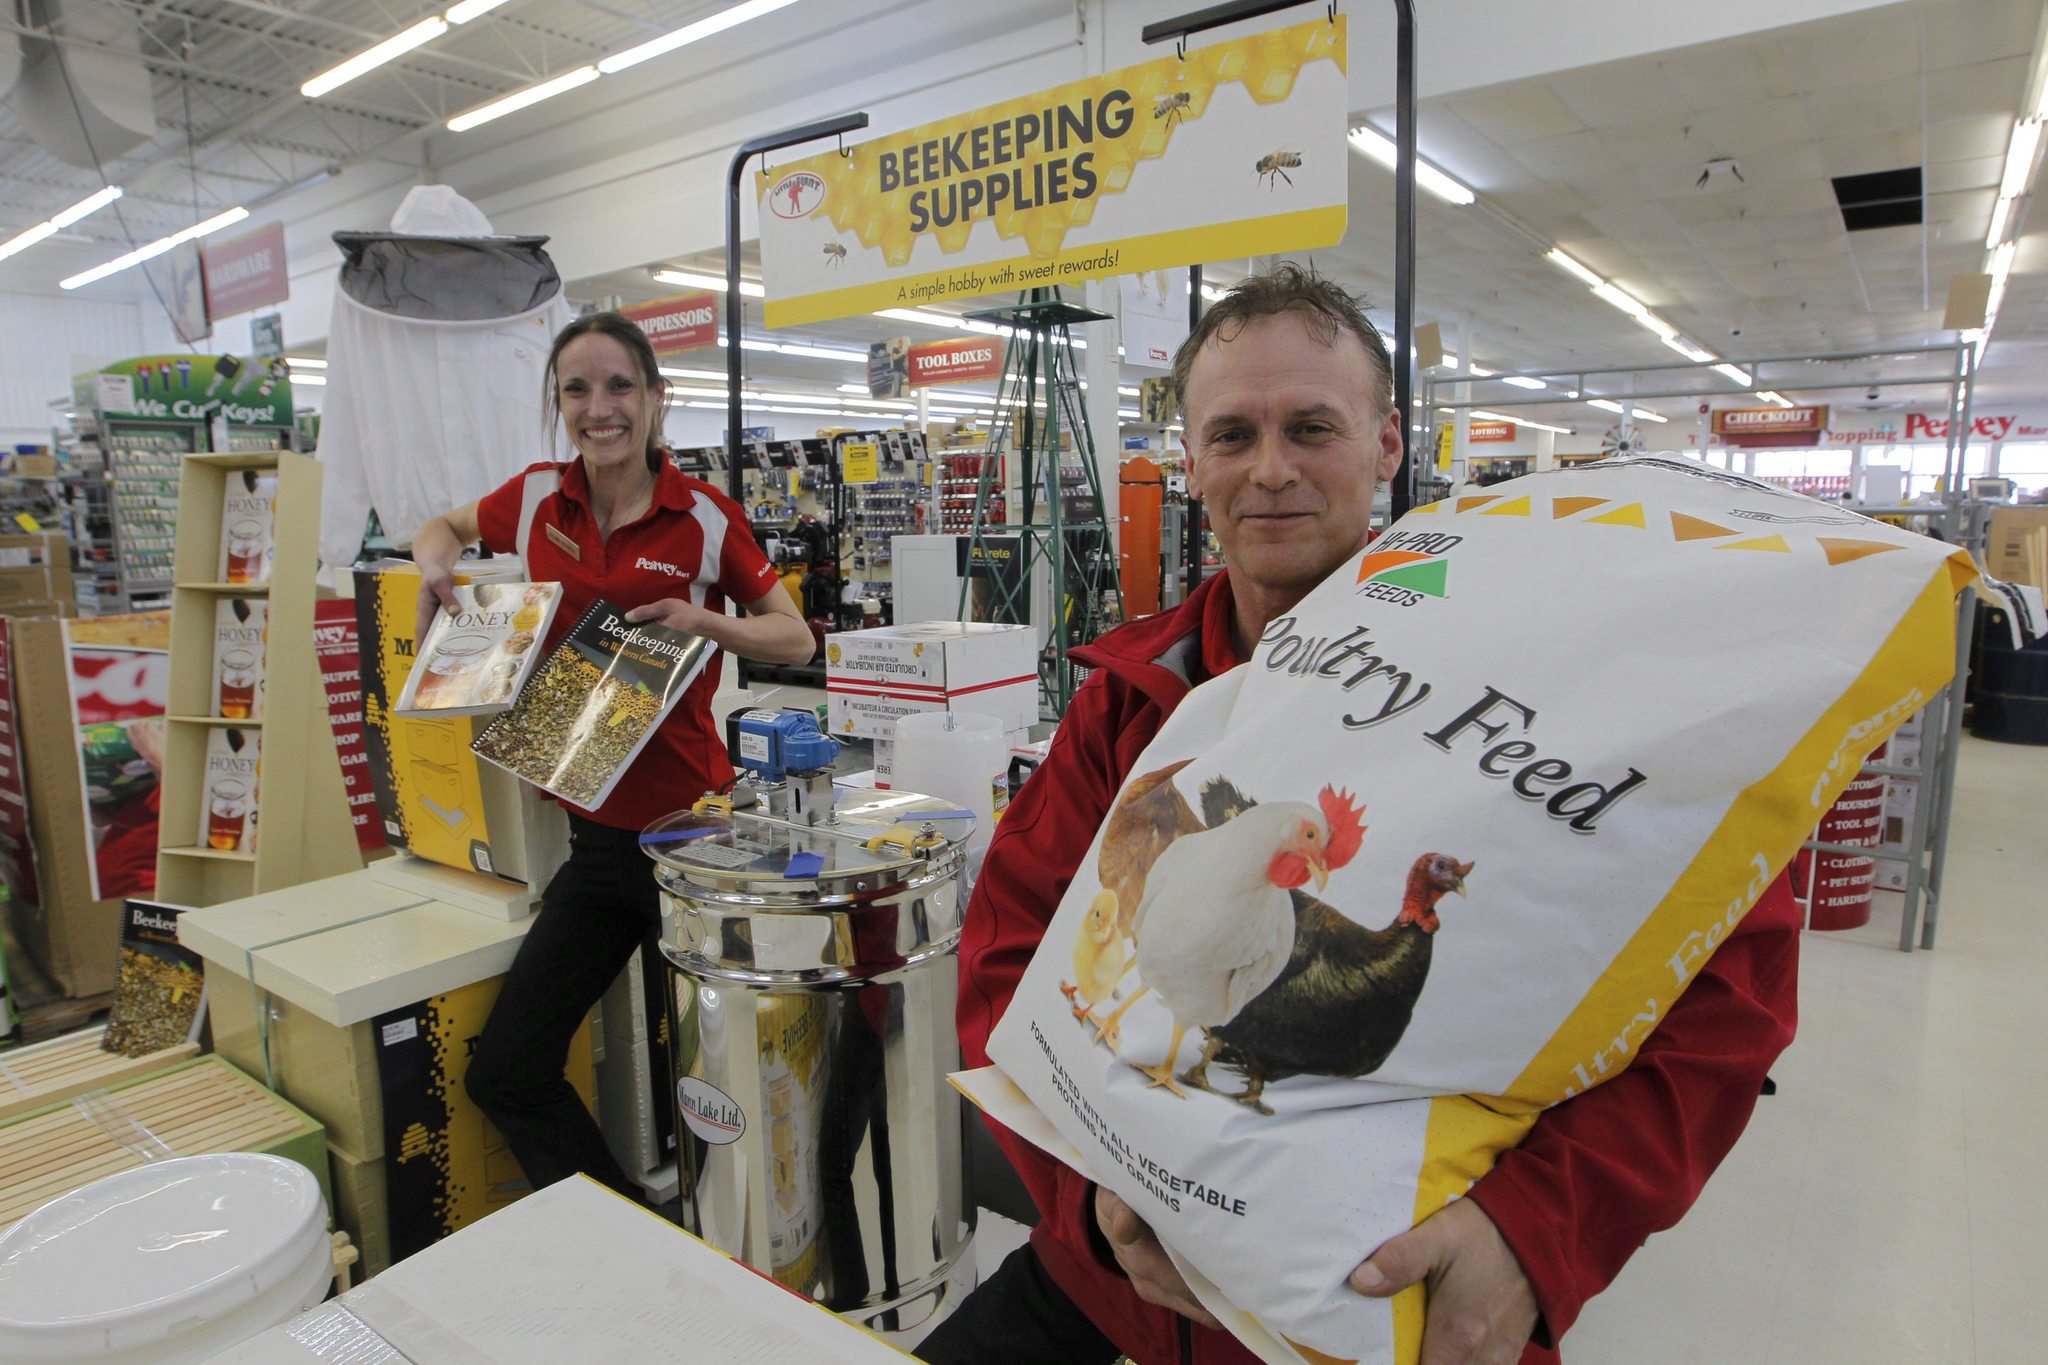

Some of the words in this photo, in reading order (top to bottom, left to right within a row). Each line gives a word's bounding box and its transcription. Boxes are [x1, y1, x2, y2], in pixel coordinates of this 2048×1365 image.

[880, 89, 1134, 192] BEEKEEPING
[910, 152, 1097, 232] SUPPLIES
[897, 287, 907, 301] A
[910, 278, 945, 301] simple
[949, 272, 986, 293] hobby
[989, 265, 1014, 285] with
[1018, 262, 1055, 281] sweet
[1059, 249, 1119, 275] rewards!
[633, 306, 713, 334] MPRESSORS
[916, 354, 950, 369] TOOL
[951, 348, 992, 366] BOXES
[133, 399, 167, 417] We
[172, 400, 205, 418] Cu
[220, 403, 276, 425] Keys!
[1724, 409, 1814, 425] CHECKOUT
[1471, 427, 1508, 436] LOTHING
[1827, 428, 1898, 443] opping
[228, 497, 269, 512] HONEY
[634, 557, 677, 576] Peavey
[1356, 582, 1424, 607] FEEDS
[218, 628, 260, 640] HONEY
[600, 613, 688, 664] Beekeeping
[209, 757, 253, 772] HONEY
[1423, 685, 1648, 832] Feed
[1835, 819, 1861, 830] TOOL
[1829, 877, 1848, 888] PET
[132, 909, 177, 931] Beekee
[1665, 851, 1770, 988] Feed
[698, 1096, 719, 1122] Lake
[721, 1105, 741, 1128] Ltd.
[1031, 1020, 1080, 1101] FORMULATED
[1081, 1096, 1108, 1135] WITH
[1111, 1132, 1134, 1160] ALL
[1138, 1153, 1247, 1217] VEGETABLE
[1052, 1073, 1097, 1137] PROTEINS
[1100, 1135, 1123, 1165] AND
[1127, 1163, 1181, 1213] GRAINS
